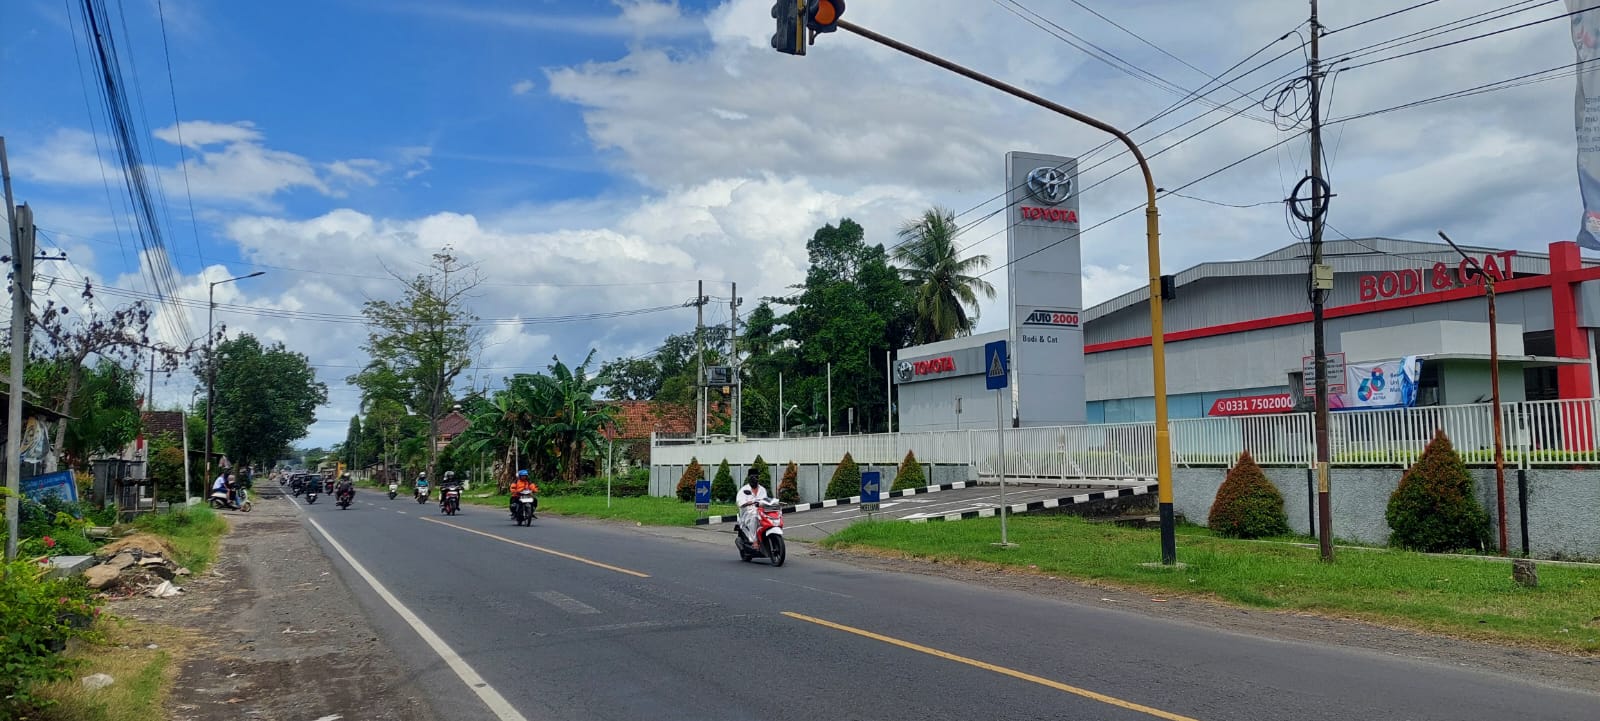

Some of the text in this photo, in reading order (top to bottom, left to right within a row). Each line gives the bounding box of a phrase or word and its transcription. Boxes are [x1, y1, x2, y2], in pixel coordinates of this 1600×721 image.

[1020, 205, 1078, 223] TOYOTA
[1359, 250, 1517, 300] BODI & CAT
[1025, 312, 1079, 324] AUTO 2000
[913, 356, 956, 375] TOYOTA
[1226, 397, 1296, 412] 0331 7502000
